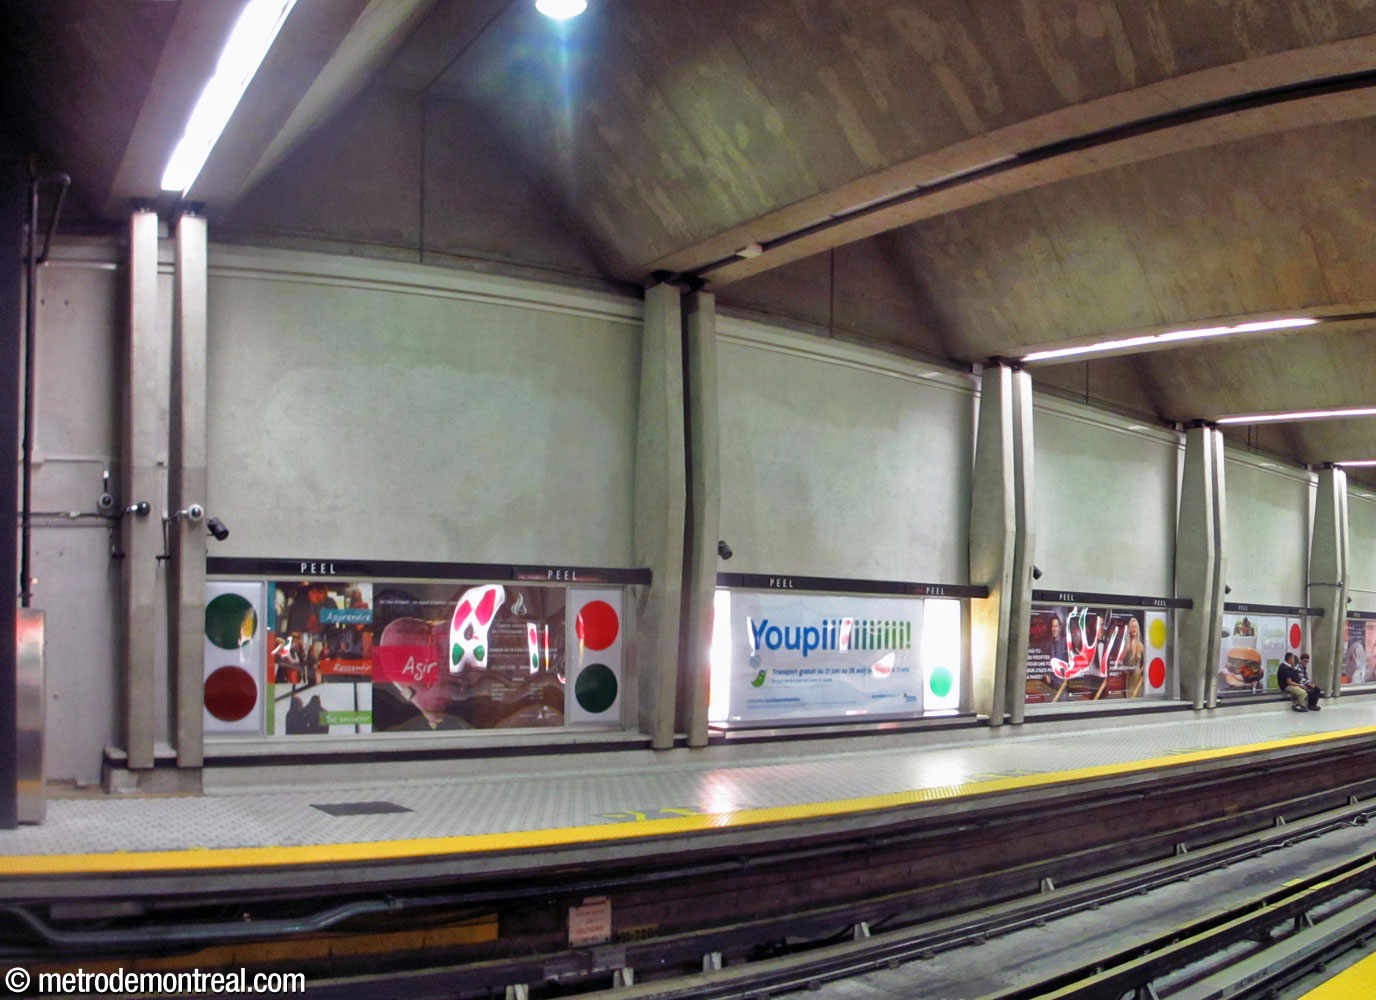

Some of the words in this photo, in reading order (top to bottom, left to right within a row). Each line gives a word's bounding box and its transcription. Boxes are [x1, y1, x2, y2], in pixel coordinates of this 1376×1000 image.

[301, 562, 336, 574] PEEL
[547, 569, 578, 580] PEEL
[769, 578, 793, 588] PEEL
[926, 586, 945, 595] PEEL
[1059, 593, 1074, 602] PEEL
[1154, 599, 1167, 607] PEEL
[326, 611, 371, 624] Apprendre
[333, 662, 372, 672] Ressentir
[402, 655, 437, 681] Agir
